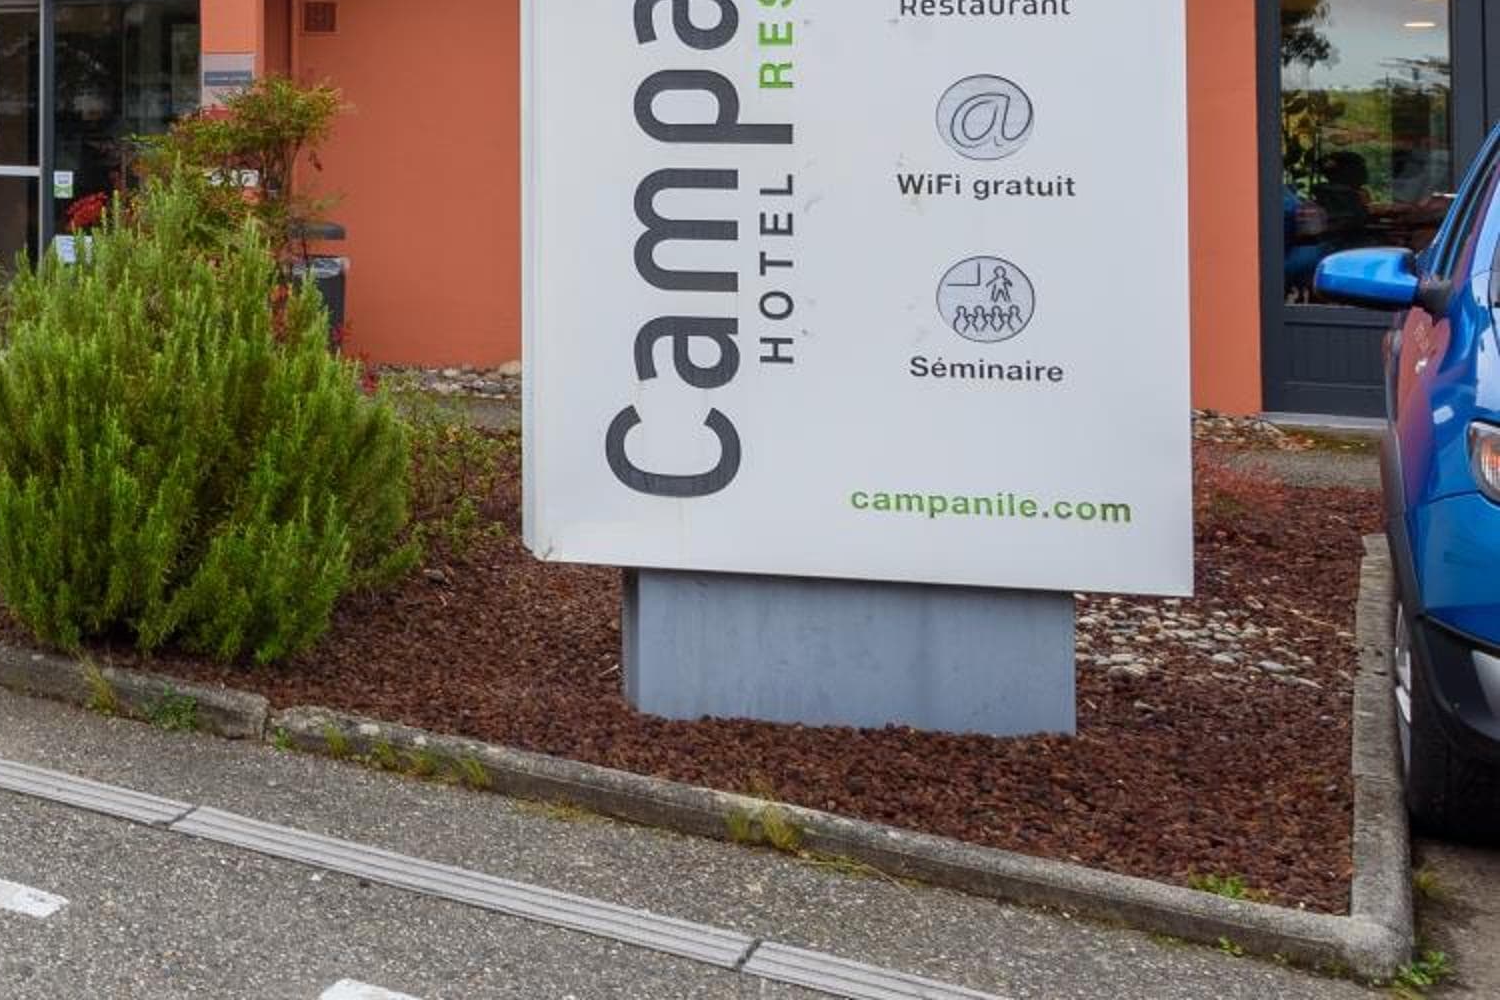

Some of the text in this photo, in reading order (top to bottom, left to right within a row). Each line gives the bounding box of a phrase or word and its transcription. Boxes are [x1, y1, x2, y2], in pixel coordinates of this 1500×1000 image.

[897, 173, 1076, 201] WiFi gratuit
[758, 173, 795, 365] HOTEL
[909, 356, 1064, 383] Séminaire
[849, 489, 1133, 524] campanile.com
